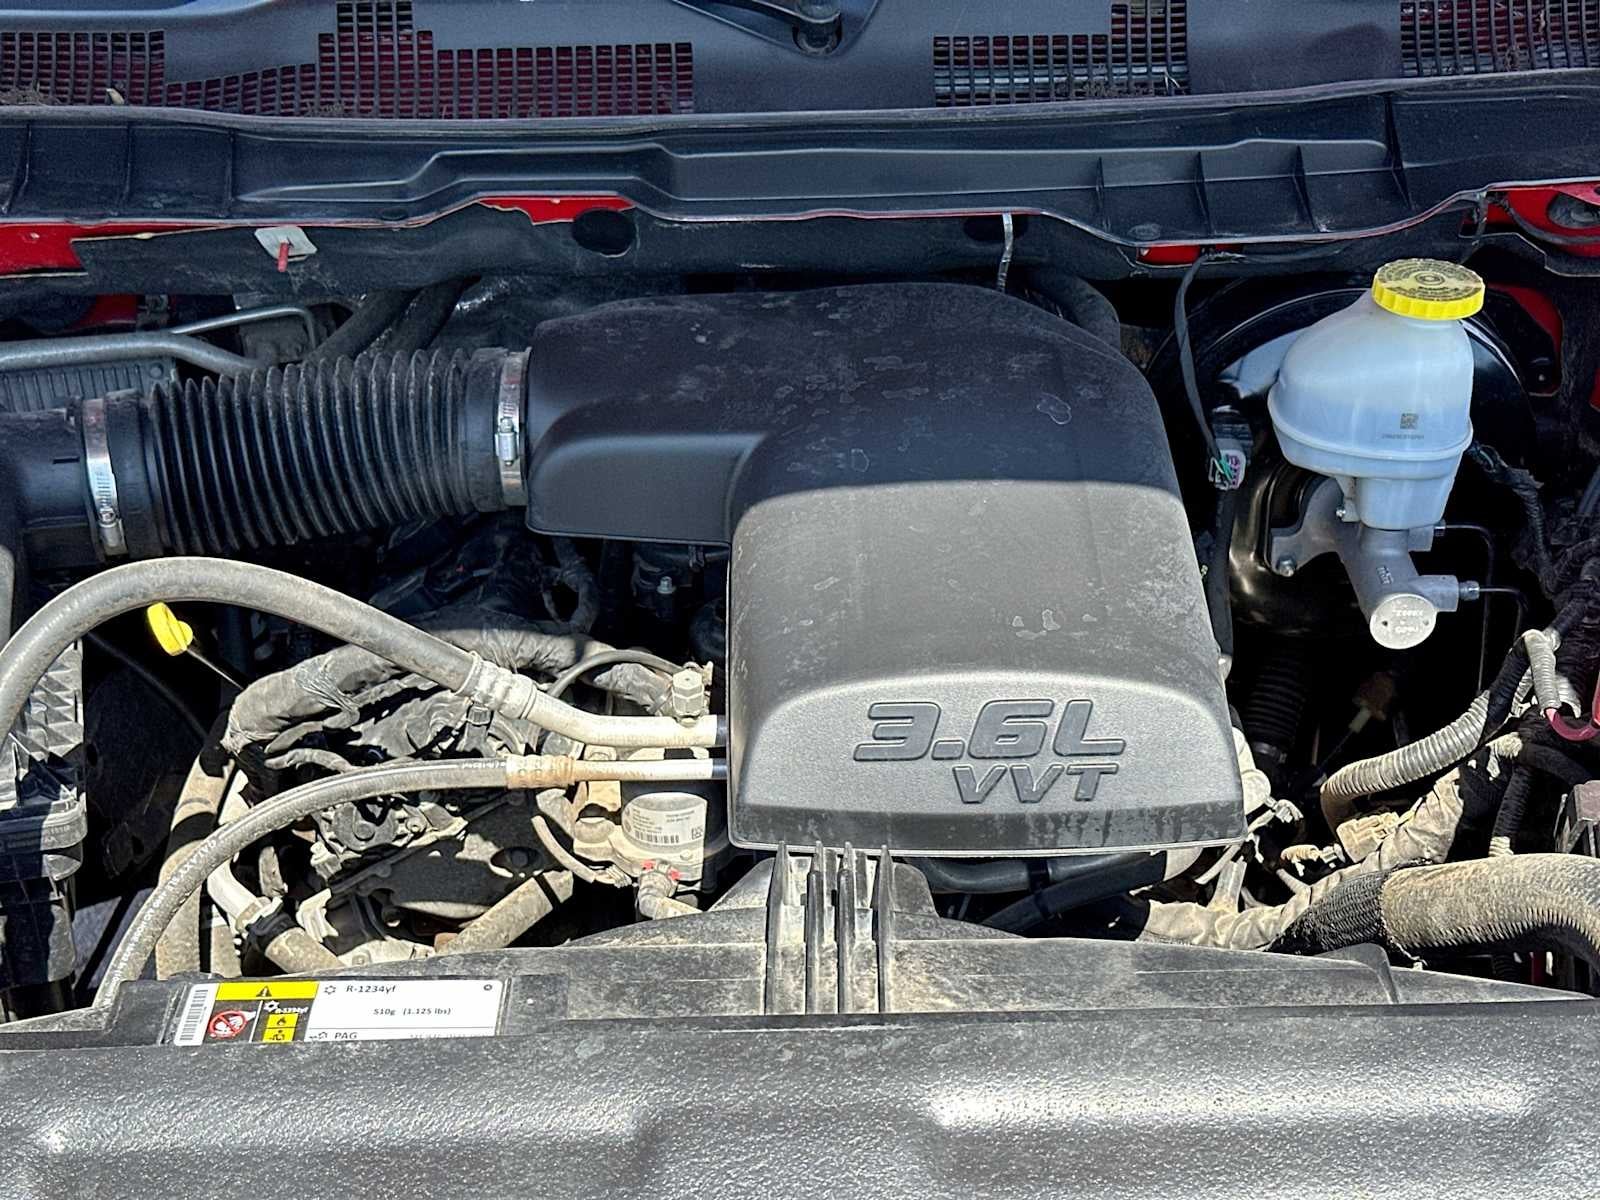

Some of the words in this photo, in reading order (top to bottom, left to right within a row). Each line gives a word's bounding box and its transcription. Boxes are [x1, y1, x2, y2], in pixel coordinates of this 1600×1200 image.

[853, 699, 1127, 761] 3.6L
[952, 763, 1119, 803] VVT
[175, 838, 219, 878] GALAXY
[346, 985, 396, 995] R-1234yf
[334, 1032, 357, 1040] PAG
